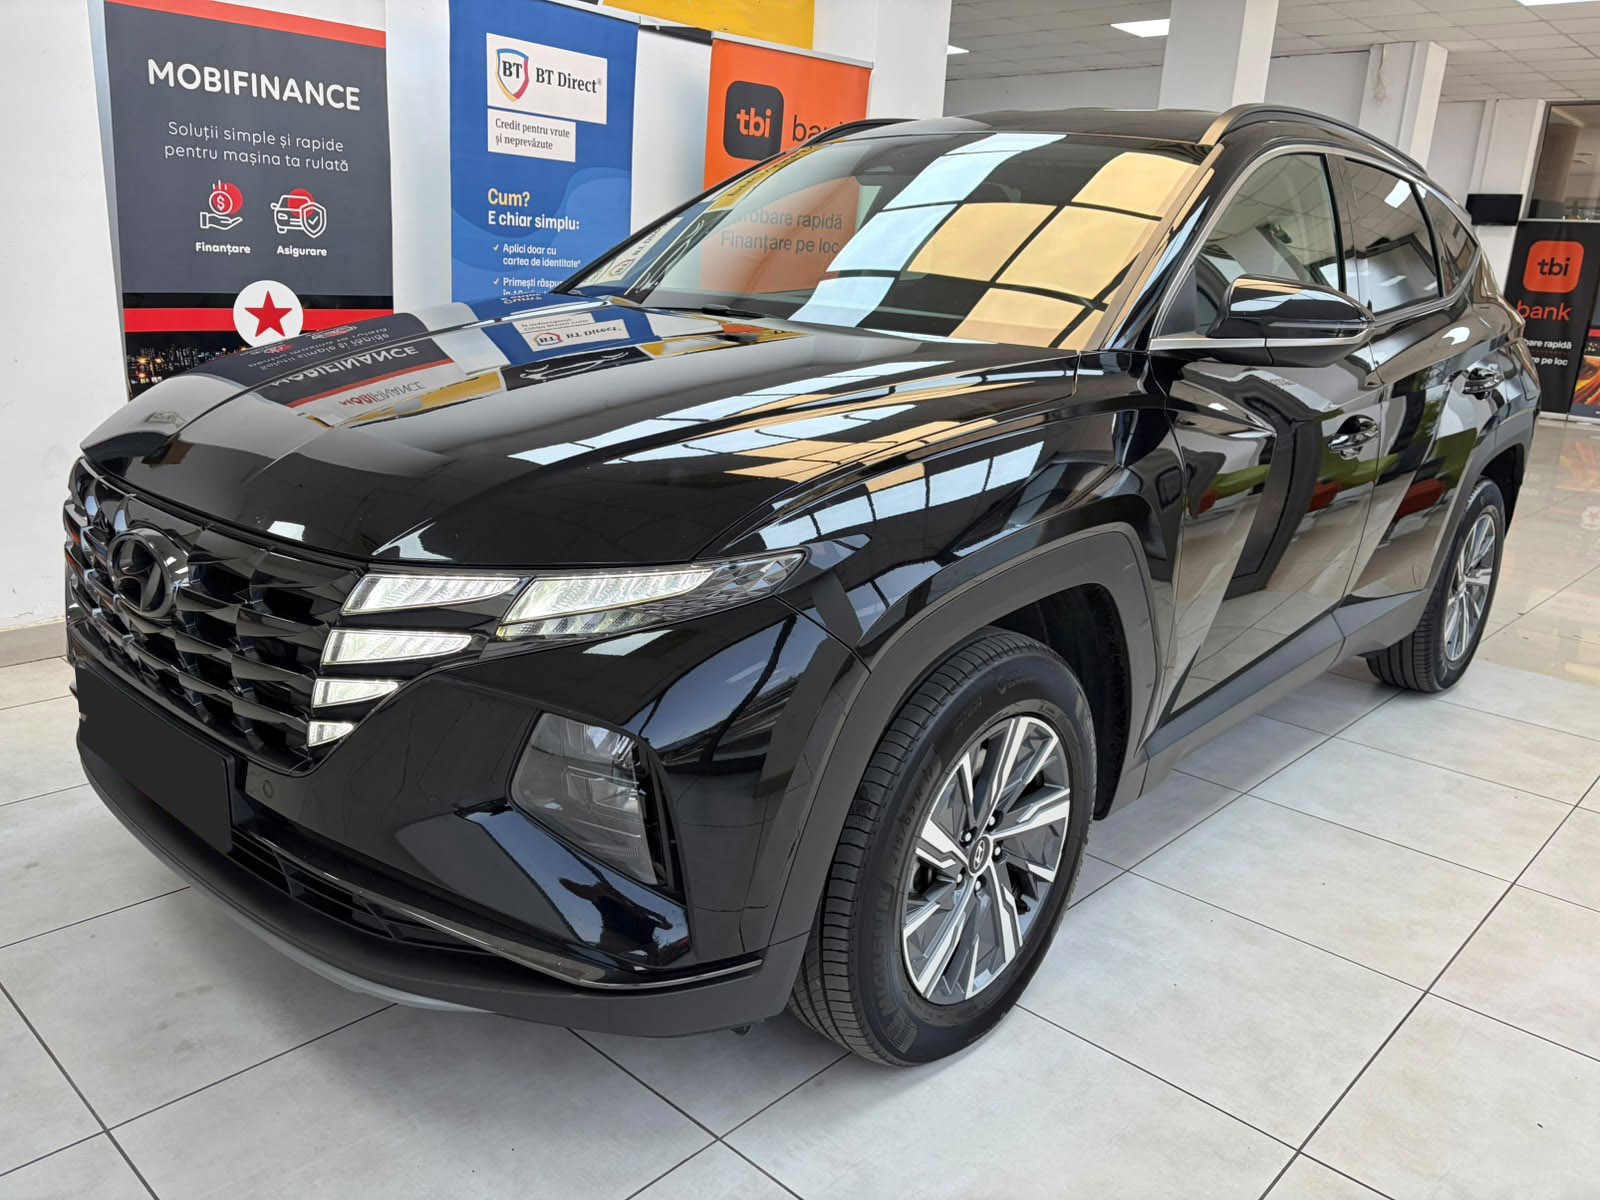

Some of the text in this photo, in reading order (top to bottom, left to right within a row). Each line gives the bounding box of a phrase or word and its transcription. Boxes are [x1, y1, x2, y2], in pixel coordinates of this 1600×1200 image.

[501, 60, 523, 79] BT
[535, 67, 554, 85] BT
[147, 58, 361, 111] MOBIFINANCE
[495, 117, 570, 139] Credit pentru vrute
[736, 107, 772, 138] tbi
[792, 114, 843, 142] ba
[168, 121, 344, 153] Soluții simple și rapide
[495, 133, 554, 150] și neprevăzute
[164, 144, 349, 172] pentru mașina ta rulată
[488, 188, 531, 208] Cum?
[488, 210, 580, 232] E chiar simplu:
[796, 212, 843, 232] rapidă
[195, 241, 251, 256] Finanțare
[276, 245, 328, 257] Asigurare
[502, 243, 557, 256] Aplici doar cu
[720, 231, 840, 255] Finanțare pe loc
[502, 256, 529, 266] cartea
[530, 257, 541, 267] de
[1537, 257, 1571, 277] tbi
[502, 277, 563, 291] Primești răspu
[1517, 300, 1572, 321] bank
[1543, 341, 1573, 350] rapidă
[1541, 358, 1553, 366] pe
[1554, 357, 1569, 367] loc
